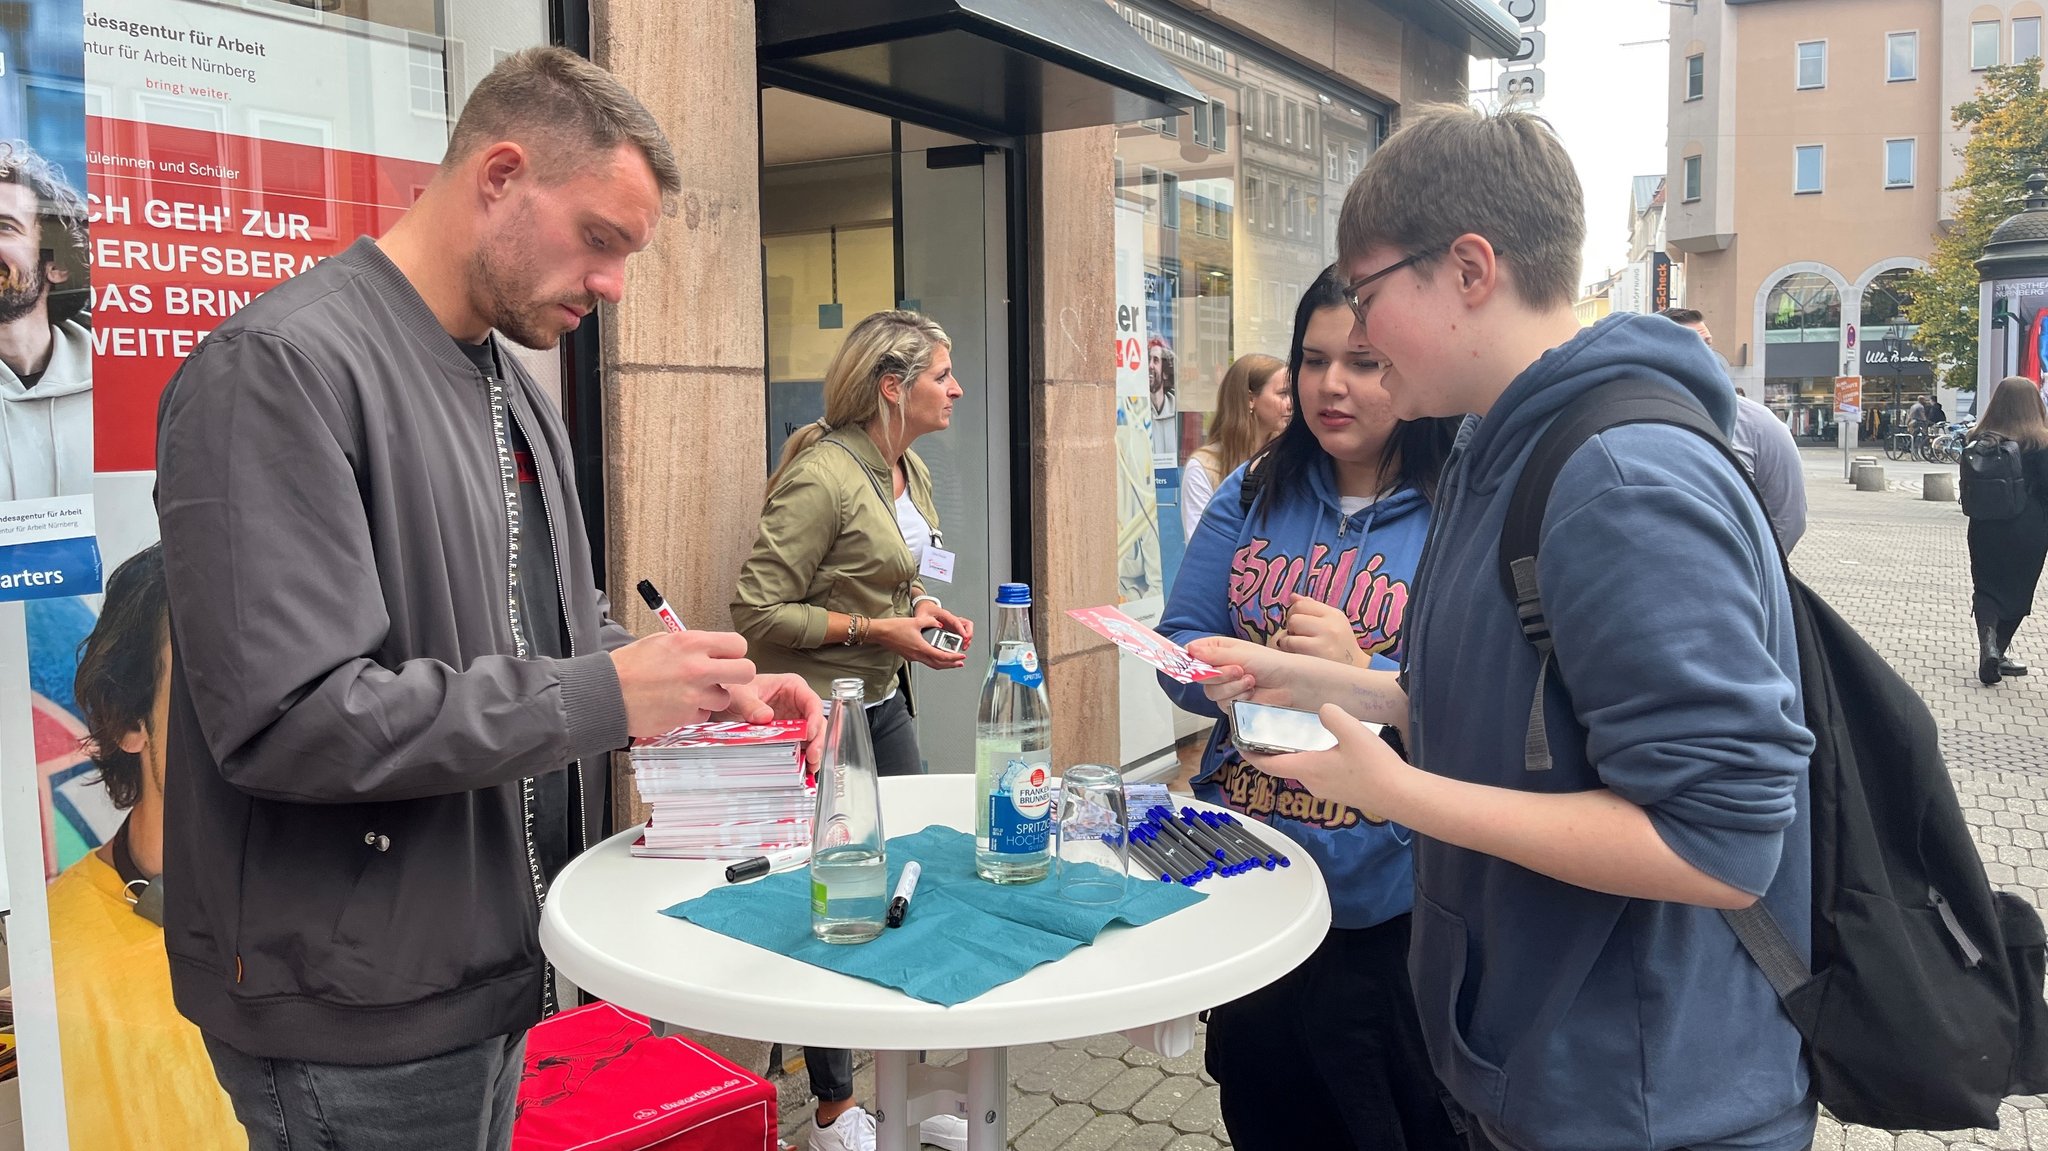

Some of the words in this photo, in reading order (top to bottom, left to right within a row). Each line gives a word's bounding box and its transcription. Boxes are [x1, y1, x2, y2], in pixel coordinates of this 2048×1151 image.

[189, 30, 213, 46] für
[217, 35, 266, 57] Arbeit
[84, 41, 114, 56] ntur
[119, 44, 139, 60] für
[144, 49, 187, 69] Arbeit
[192, 57, 256, 83] Nürnberg
[146, 78, 184, 96] bringt
[189, 86, 232, 101] weiter.
[159, 161, 185, 174] und
[189, 162, 240, 180] Schüler
[144, 200, 231, 233] GEH'
[242, 209, 312, 242] ZUR
[89, 238, 329, 279] ERUFSBERA
[165, 286, 265, 317] BRIN
[1116, 304, 1139, 332] er
[91, 326, 209, 359] WEITE
[1865, 350, 1888, 363] Ulla
[493, 386, 514, 479] KLEINIGKEIT
[59, 508, 82, 517] Arbeit
[16, 525, 26, 533] für
[27, 523, 47, 532] Arbeit
[48, 521, 79, 530] Nürnberg
[0, 569, 64, 589] arters
